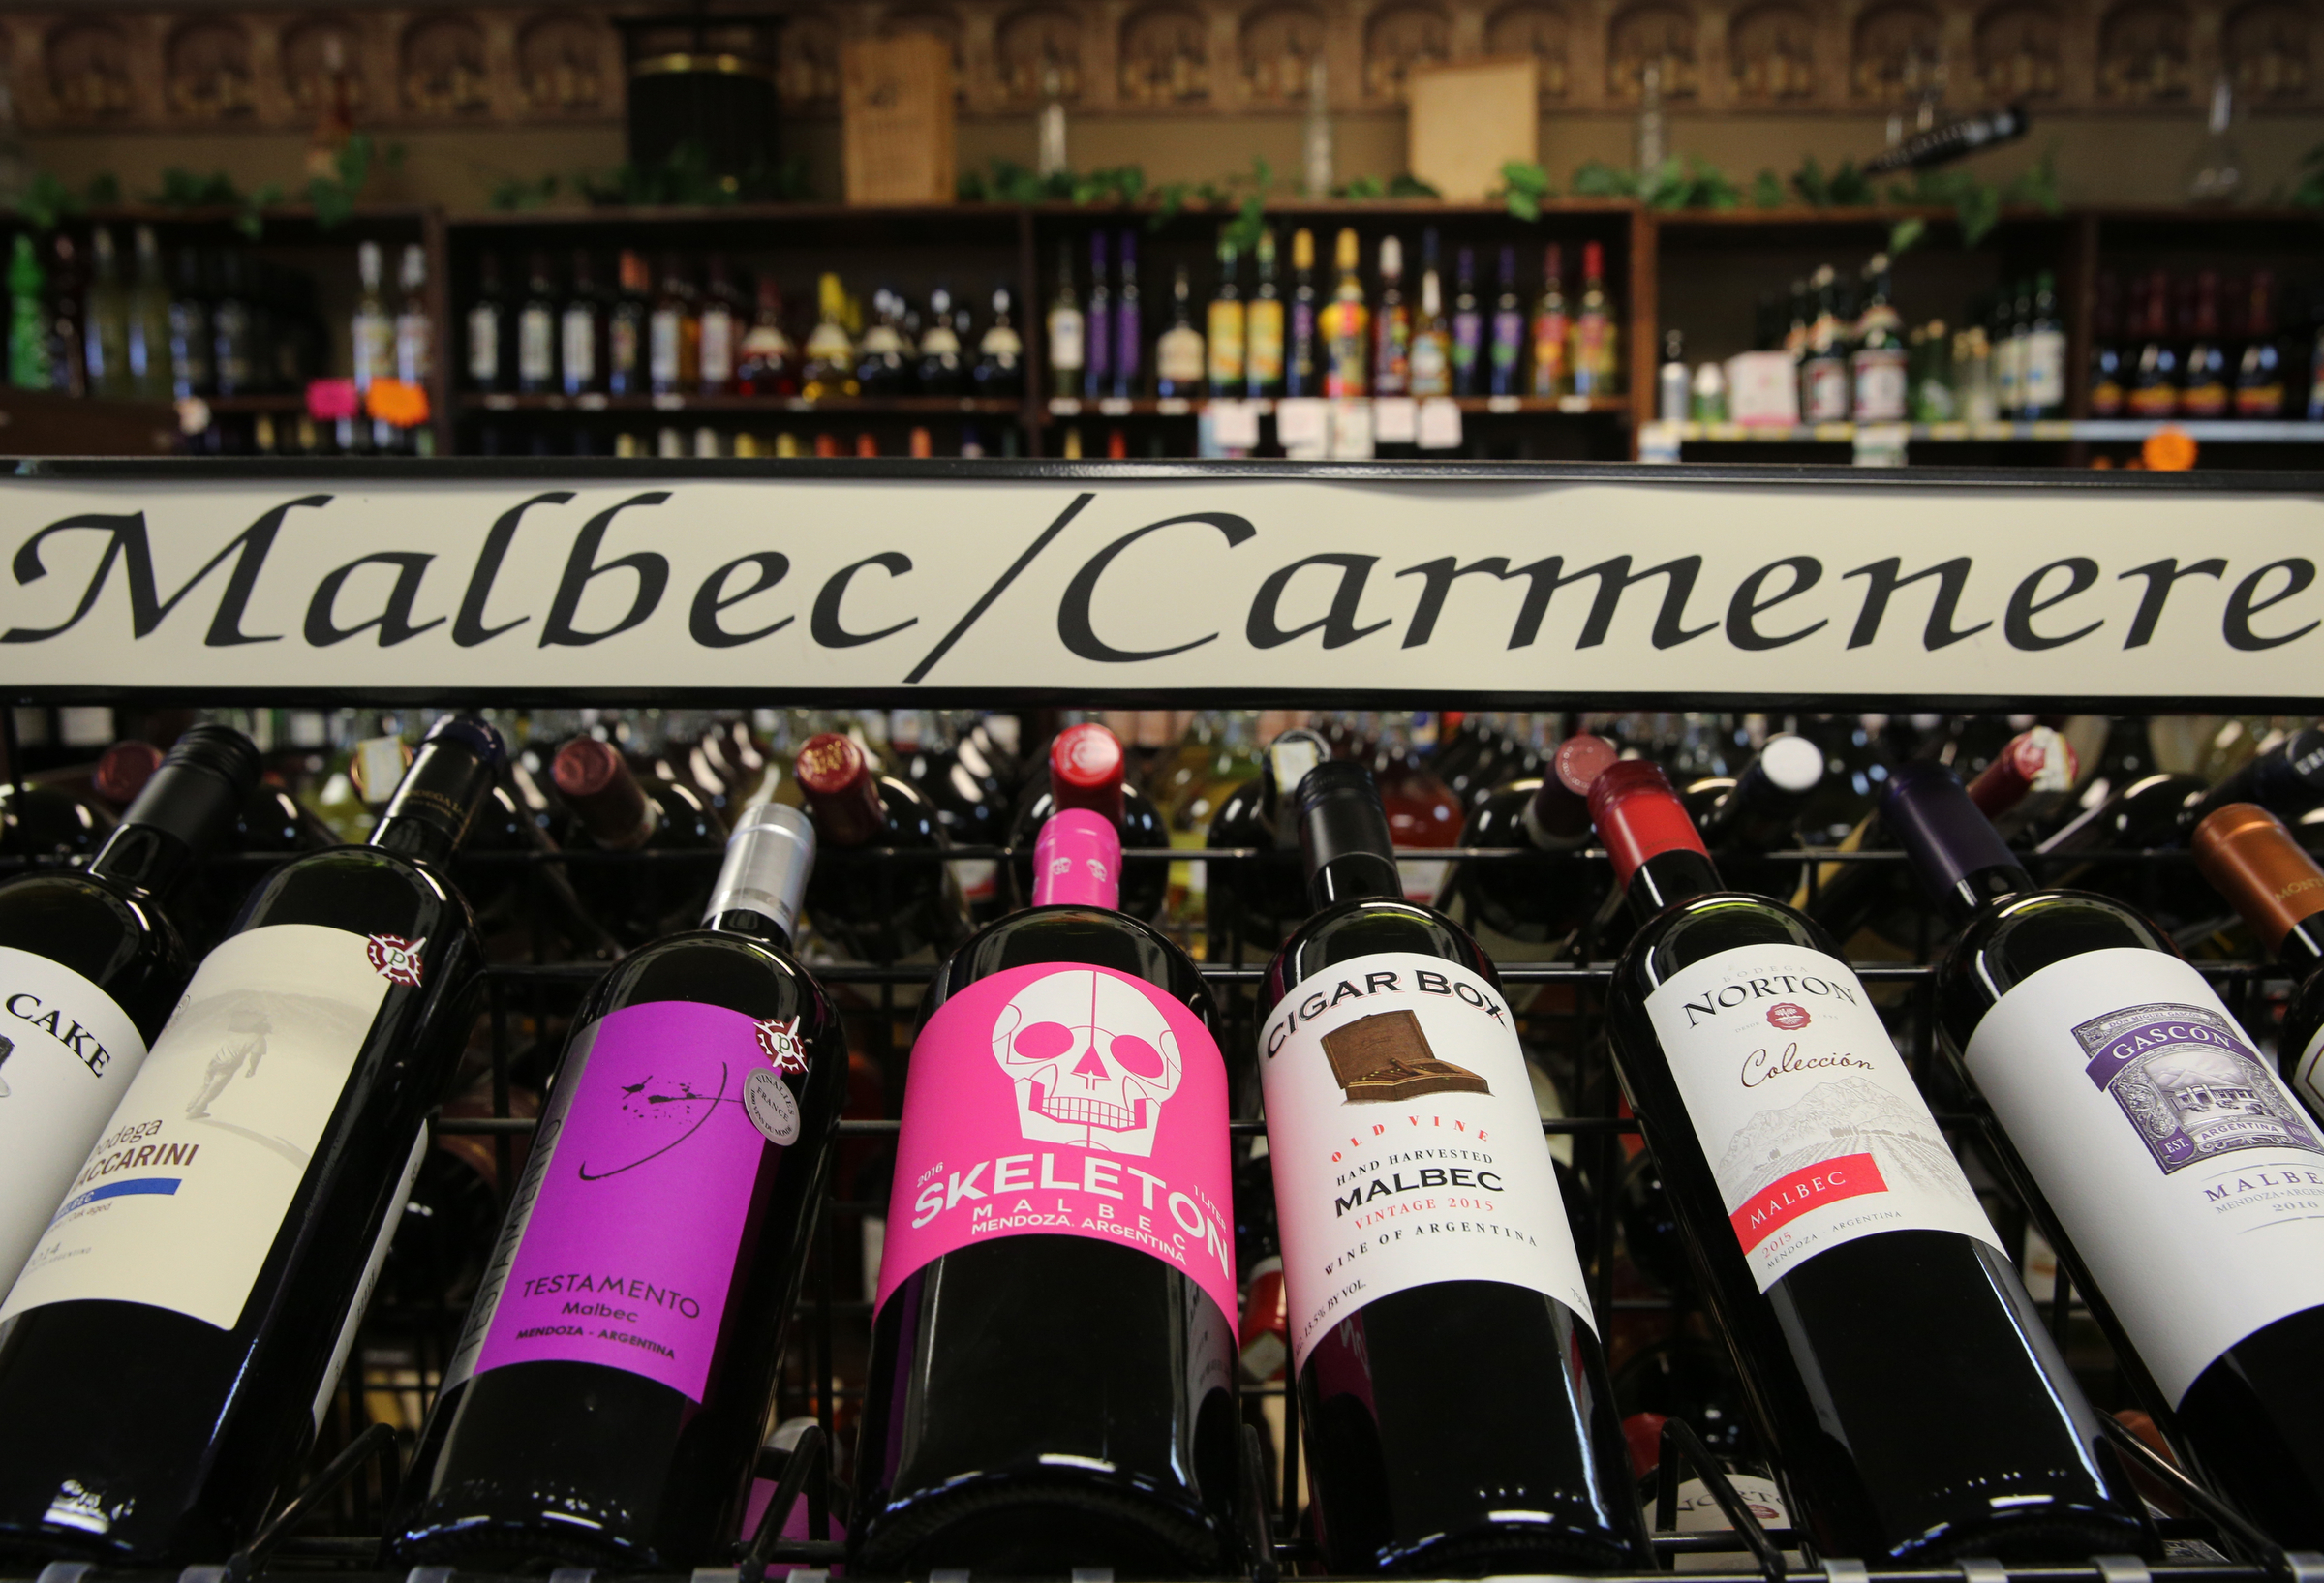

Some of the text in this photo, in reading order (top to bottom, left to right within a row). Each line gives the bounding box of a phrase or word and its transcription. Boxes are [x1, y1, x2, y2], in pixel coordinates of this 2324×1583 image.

[0, 491, 2321, 685] Malbec/Carmenere
[1723, 965, 1808, 983] BODEGA
[1268, 970, 1509, 1059] CIGAR BOX
[1682, 975, 1857, 1029] NORTON
[2109, 1018, 2129, 1029] DON
[2131, 1012, 2168, 1022] MIGUEL
[5, 993, 110, 1079] CAKE
[1741, 1042, 1874, 1087] Colección
[755, 1074, 794, 1115] VINALIES
[756, 1086, 789, 1122] FRANCE
[1331, 1115, 1488, 1163] OLD VINE
[2164, 1137, 2190, 1154] EST.
[2201, 1122, 2280, 1140] ARGENTINA
[917, 1161, 944, 1188] 2016
[1336, 1148, 1493, 1187] HAND HARVESTED
[1201, 1191, 1227, 1233] LITER
[1334, 1168, 1505, 1218] MALBEC
[1355, 1197, 1494, 1230] VINTAGE 2015
[1750, 1172, 1846, 1230] MALBEC
[2272, 1201, 2319, 1212] 2016
[911, 1153, 1229, 1280] SKELETON
[972, 1198, 1187, 1251] MALBEC
[1081, 1218, 1186, 1265] ARGENTINA
[1325, 1221, 1538, 1276] WINE OF ARGENTINA
[1761, 1231, 1792, 1259] 2015
[1766, 1210, 1902, 1270] MENDOZA ARGENTINA
[523, 1274, 700, 1319] TESTAMENTO
[561, 1302, 639, 1323] Malbec
[1328, 1293, 1339, 1311] BY
[1341, 1278, 1367, 1297] VOL.
[516, 1325, 675, 1359] MENDOZA ARGENTINA
